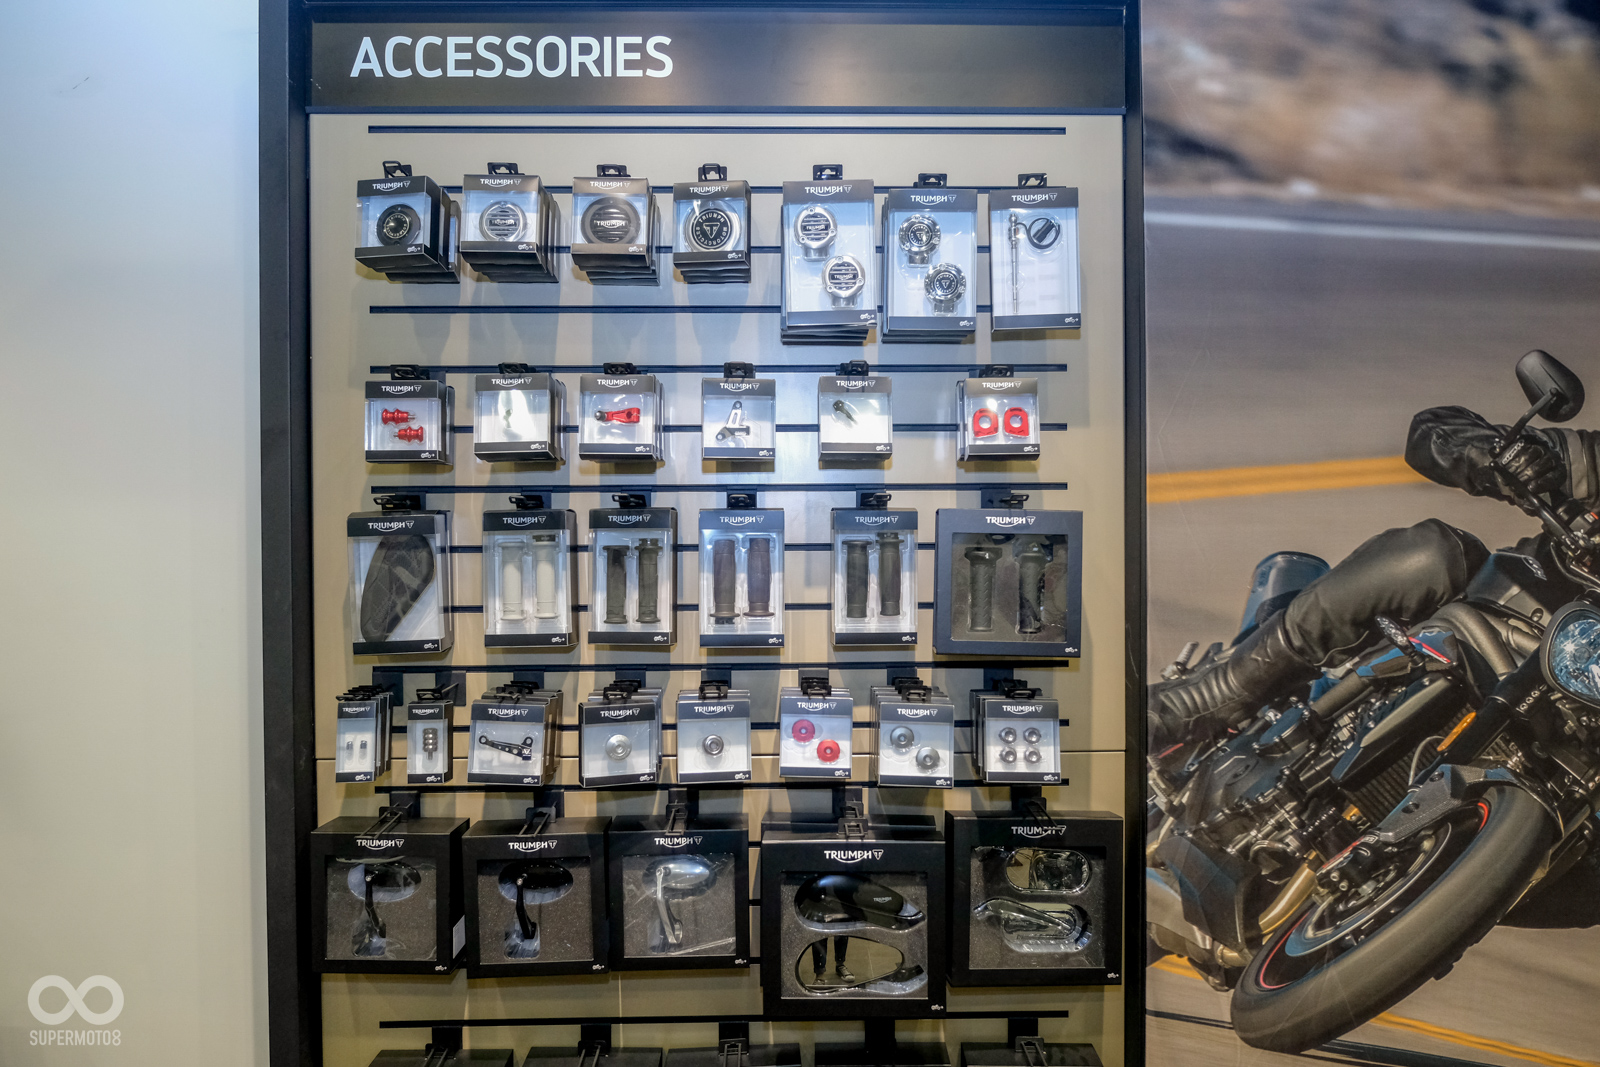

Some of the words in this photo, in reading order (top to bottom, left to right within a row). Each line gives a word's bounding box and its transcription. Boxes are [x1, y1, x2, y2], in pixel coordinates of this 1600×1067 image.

[350, 35, 673, 78] ACCESSORIES
[372, 181, 404, 191] TRIUMPH
[480, 178, 513, 187] TRIUMPH
[590, 181, 623, 189] TRIUMPH
[689, 186, 721, 195] TRIUMPH
[804, 186, 843, 196] TRIUMPH
[910, 194, 947, 205] TRIUMPH
[1011, 194, 1048, 204] TRIUMPH
[699, 212, 725, 223] TRIUMPH
[596, 220, 626, 228] TRIUMPH
[491, 378, 524, 387] TRIUMPH
[597, 379, 630, 388] TRIUMPH
[720, 383, 752, 392] TRIUMPH
[836, 380, 868, 389] TRIUMPH
[982, 382, 1014, 390] TRIUMPH
[381, 385, 413, 394] TRIUMPH
[502, 516, 538, 527] TRIUMPH
[608, 515, 642, 525] TRIUMPH
[720, 516, 756, 526] TRIUMPH
[855, 516, 891, 526] TRIUMPH
[985, 516, 1026, 527] TRIUMPH
[368, 521, 405, 532] TRIUMPH
[694, 706, 727, 715] TRIUMPH
[797, 702, 829, 711] TRIUMPH
[1002, 705, 1036, 715] TRIUMPH
[488, 708, 521, 718] TRIUMPH
[600, 709, 633, 719] TRIUMPH
[897, 708, 930, 718] TRIUMPH
[356, 839, 395, 850] TRIUMPH
[508, 841, 548, 852] TRIUMPH
[654, 837, 693, 848] TRIUMPH
[824, 850, 872, 863] TRIUMPH
